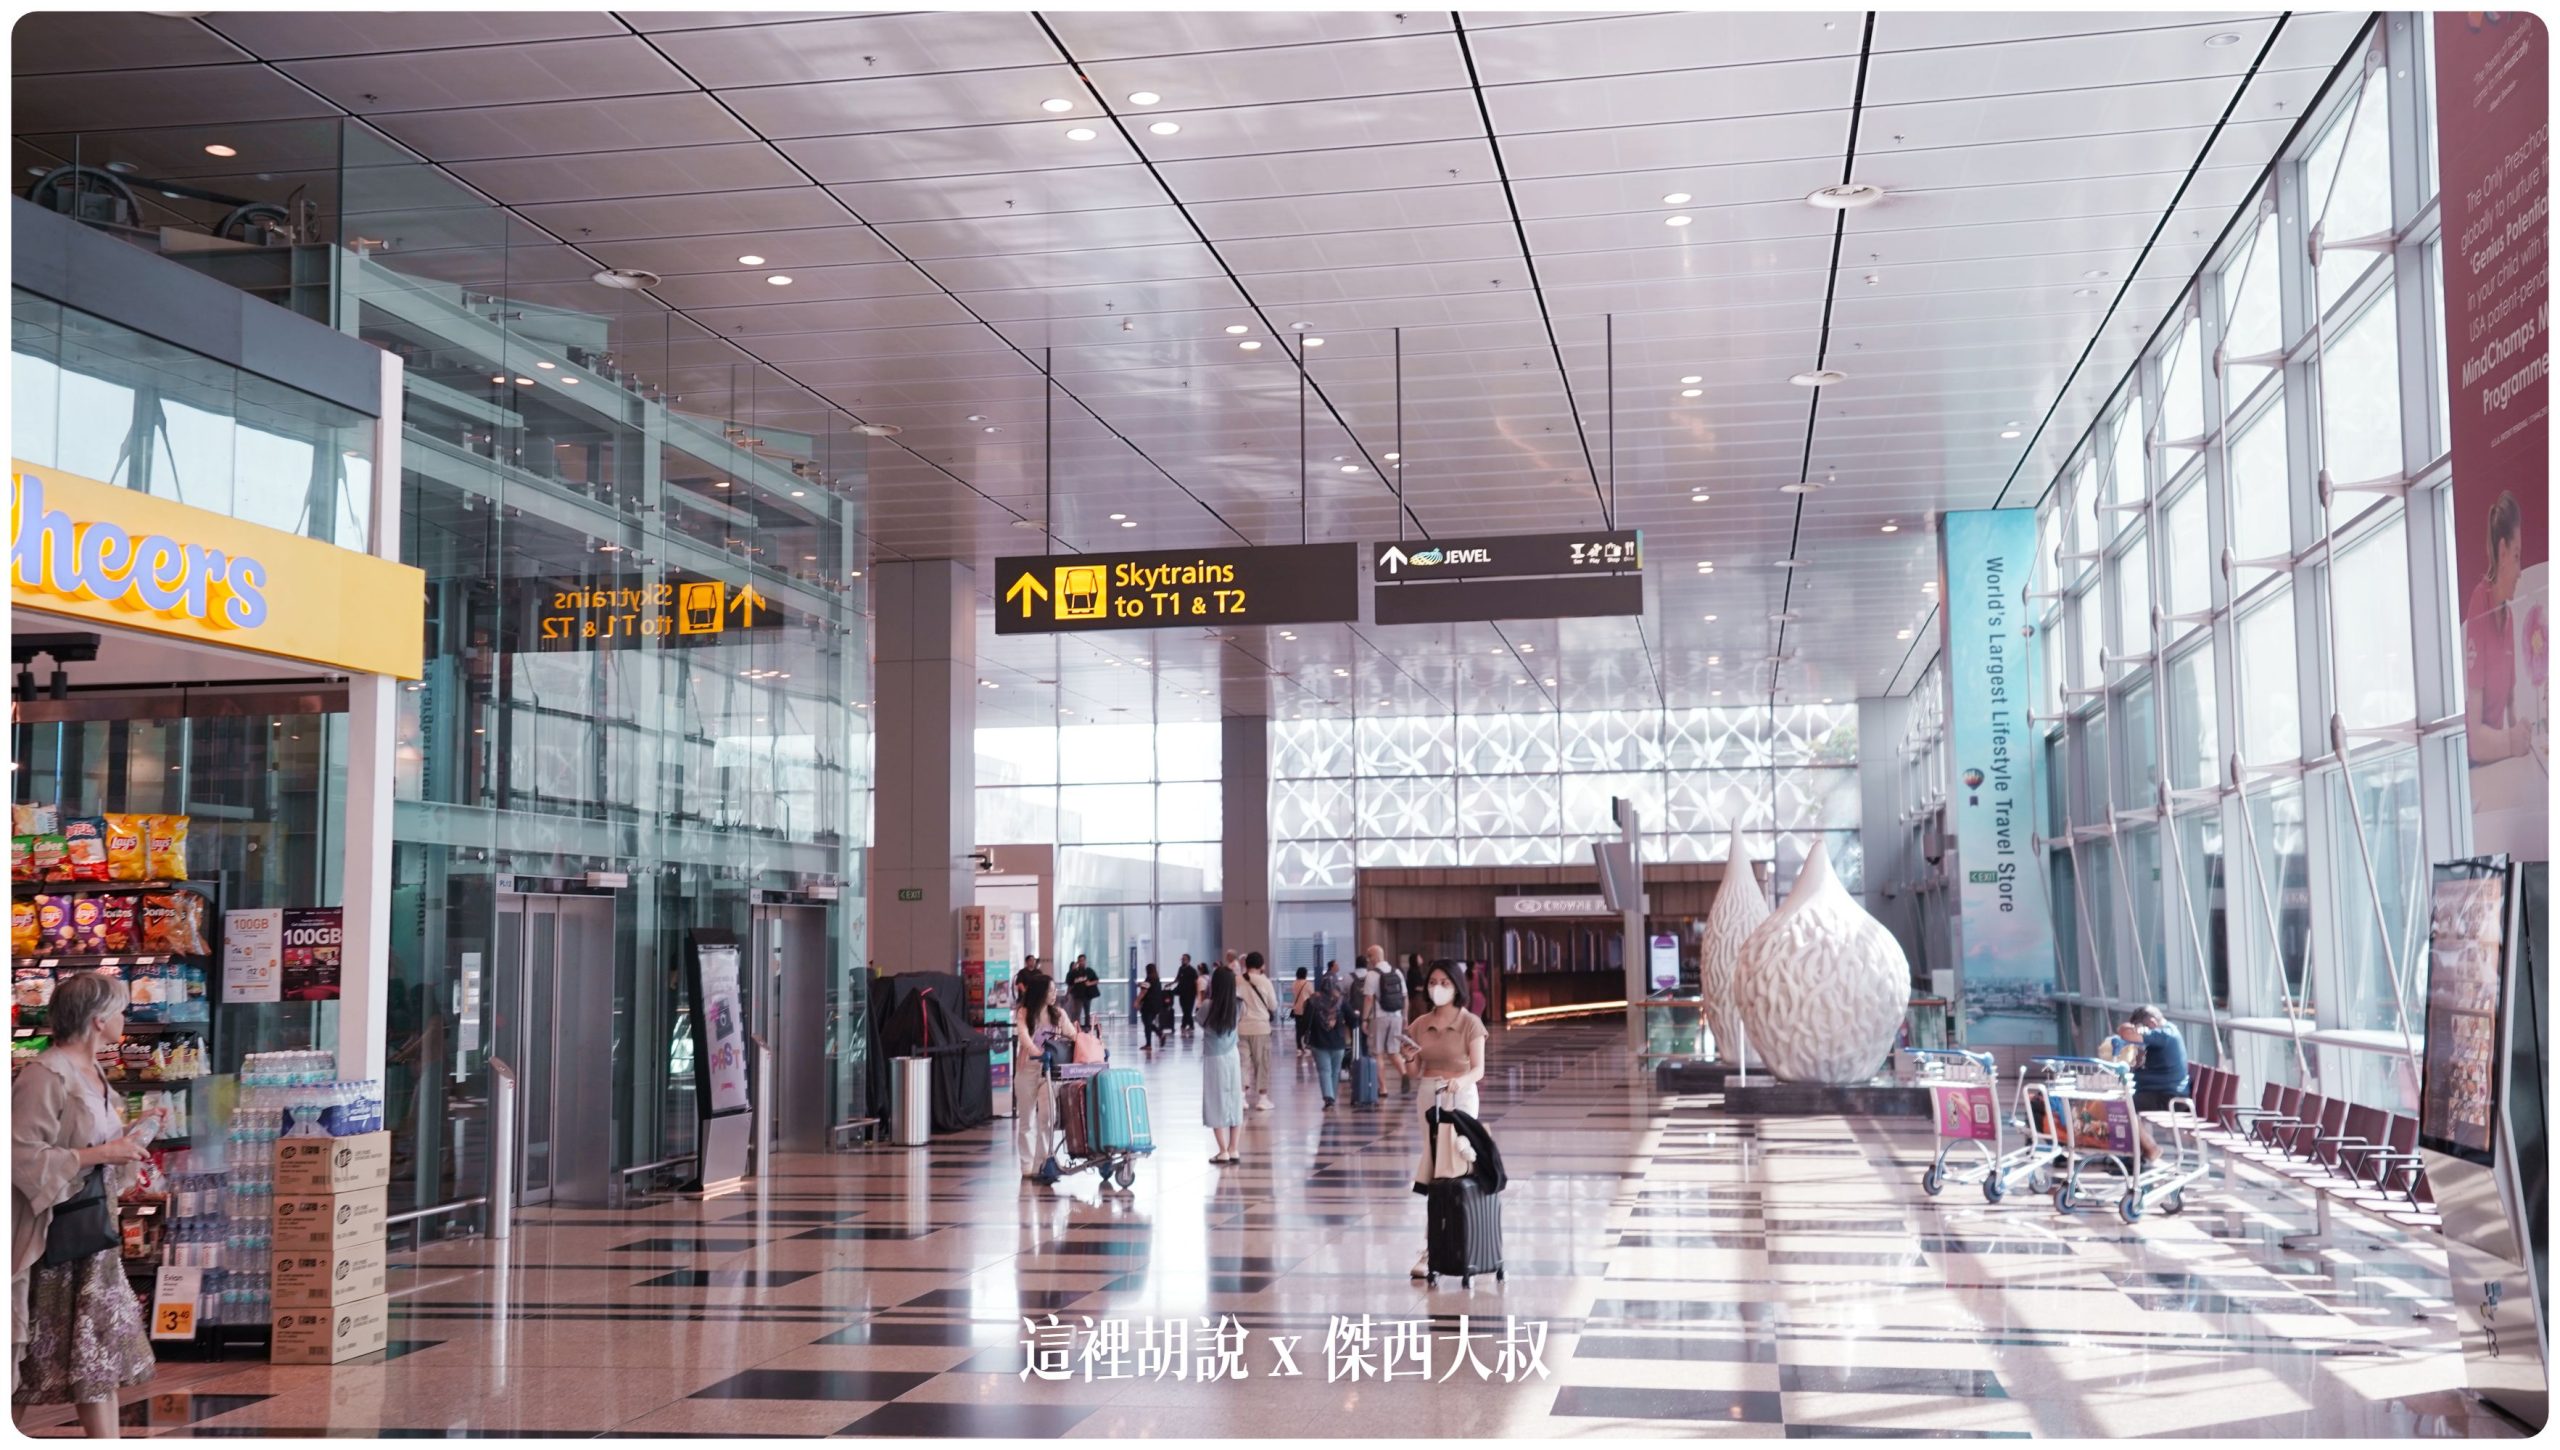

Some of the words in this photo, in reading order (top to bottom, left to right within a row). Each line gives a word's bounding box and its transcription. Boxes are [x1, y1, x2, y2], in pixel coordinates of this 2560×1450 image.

[2461, 207, 2494, 257] globally
[2495, 199, 2505, 219] to
[2506, 167, 2540, 210] nurture
[2467, 188, 2482, 214] The
[2482, 165, 2503, 198] Only
[2467, 290, 2476, 313] in
[2476, 274, 2496, 310] your
[2497, 250, 2519, 288] child
[2520, 235, 2542, 267] with
[2469, 314, 2487, 343] USA
[2461, 317, 2536, 390] MindChamps
[2482, 351, 2549, 416] Programme
[12, 474, 267, 629] heers
[1115, 559, 1235, 592] Skytrains
[1443, 549, 1491, 565] JEWEL
[1114, 596, 1144, 618] to
[1150, 592, 1180, 616] T1
[1191, 596, 1207, 615] &
[1213, 589, 1246, 614] T2
[1986, 556, 2006, 627] World's
[1986, 634, 2009, 704] Largest
[1990, 712, 2012, 791] Lifestyle
[1995, 798, 2015, 856] Travel
[906, 891, 921, 899] EXIT
[1997, 862, 2016, 913] Store
[233, 918, 269, 930] 100GB
[283, 928, 342, 946] 100GB
[965, 914, 981, 932] T3
[990, 914, 1006, 932] T3
[163, 1274, 184, 1282] Evian
